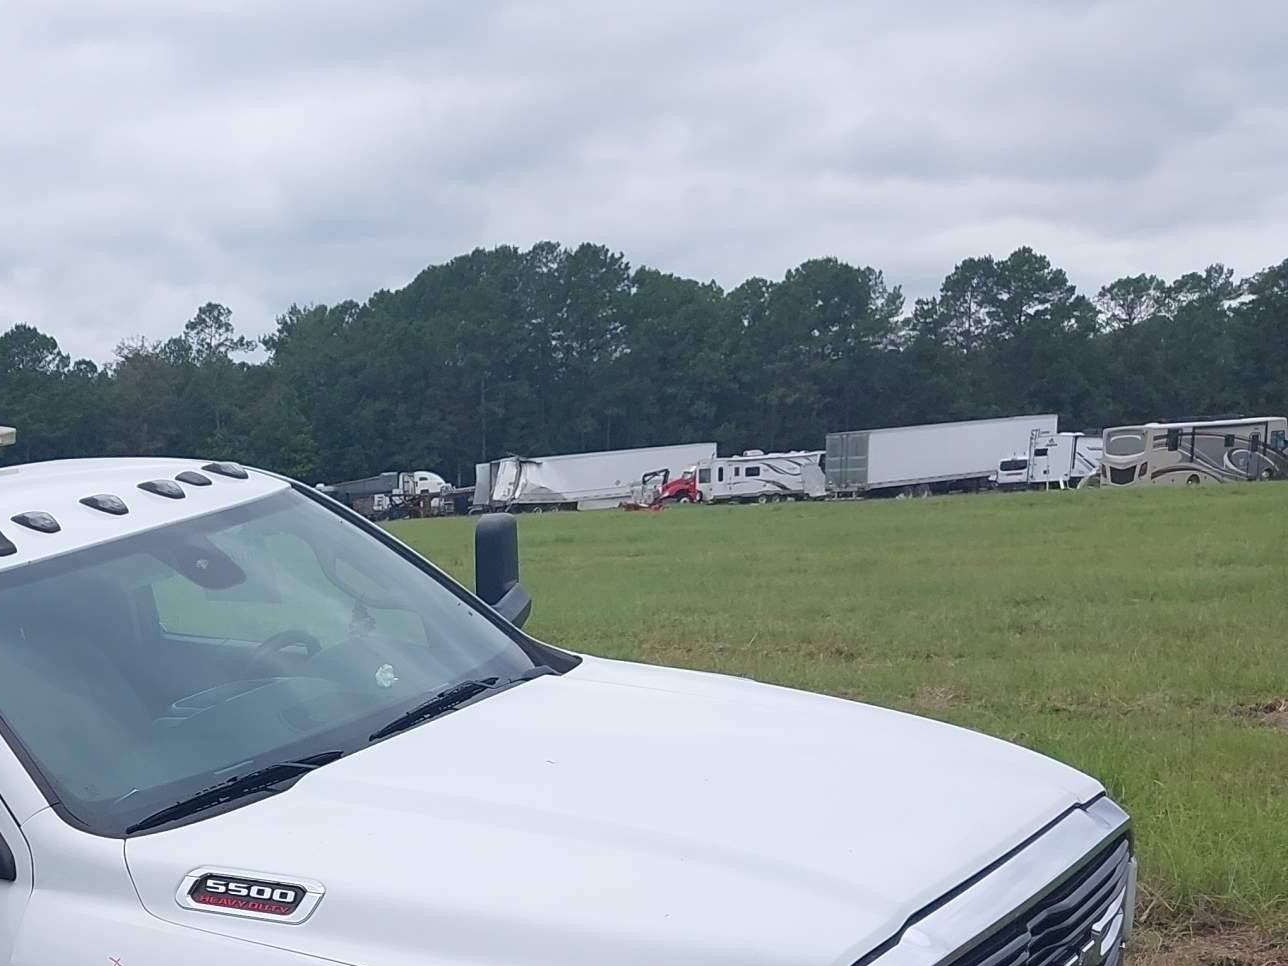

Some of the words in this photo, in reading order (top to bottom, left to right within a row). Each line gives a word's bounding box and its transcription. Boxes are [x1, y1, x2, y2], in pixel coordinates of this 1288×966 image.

[205, 879, 296, 903] 5500
[199, 894, 247, 908] HEAVY
[247, 901, 290, 913] DUTY
